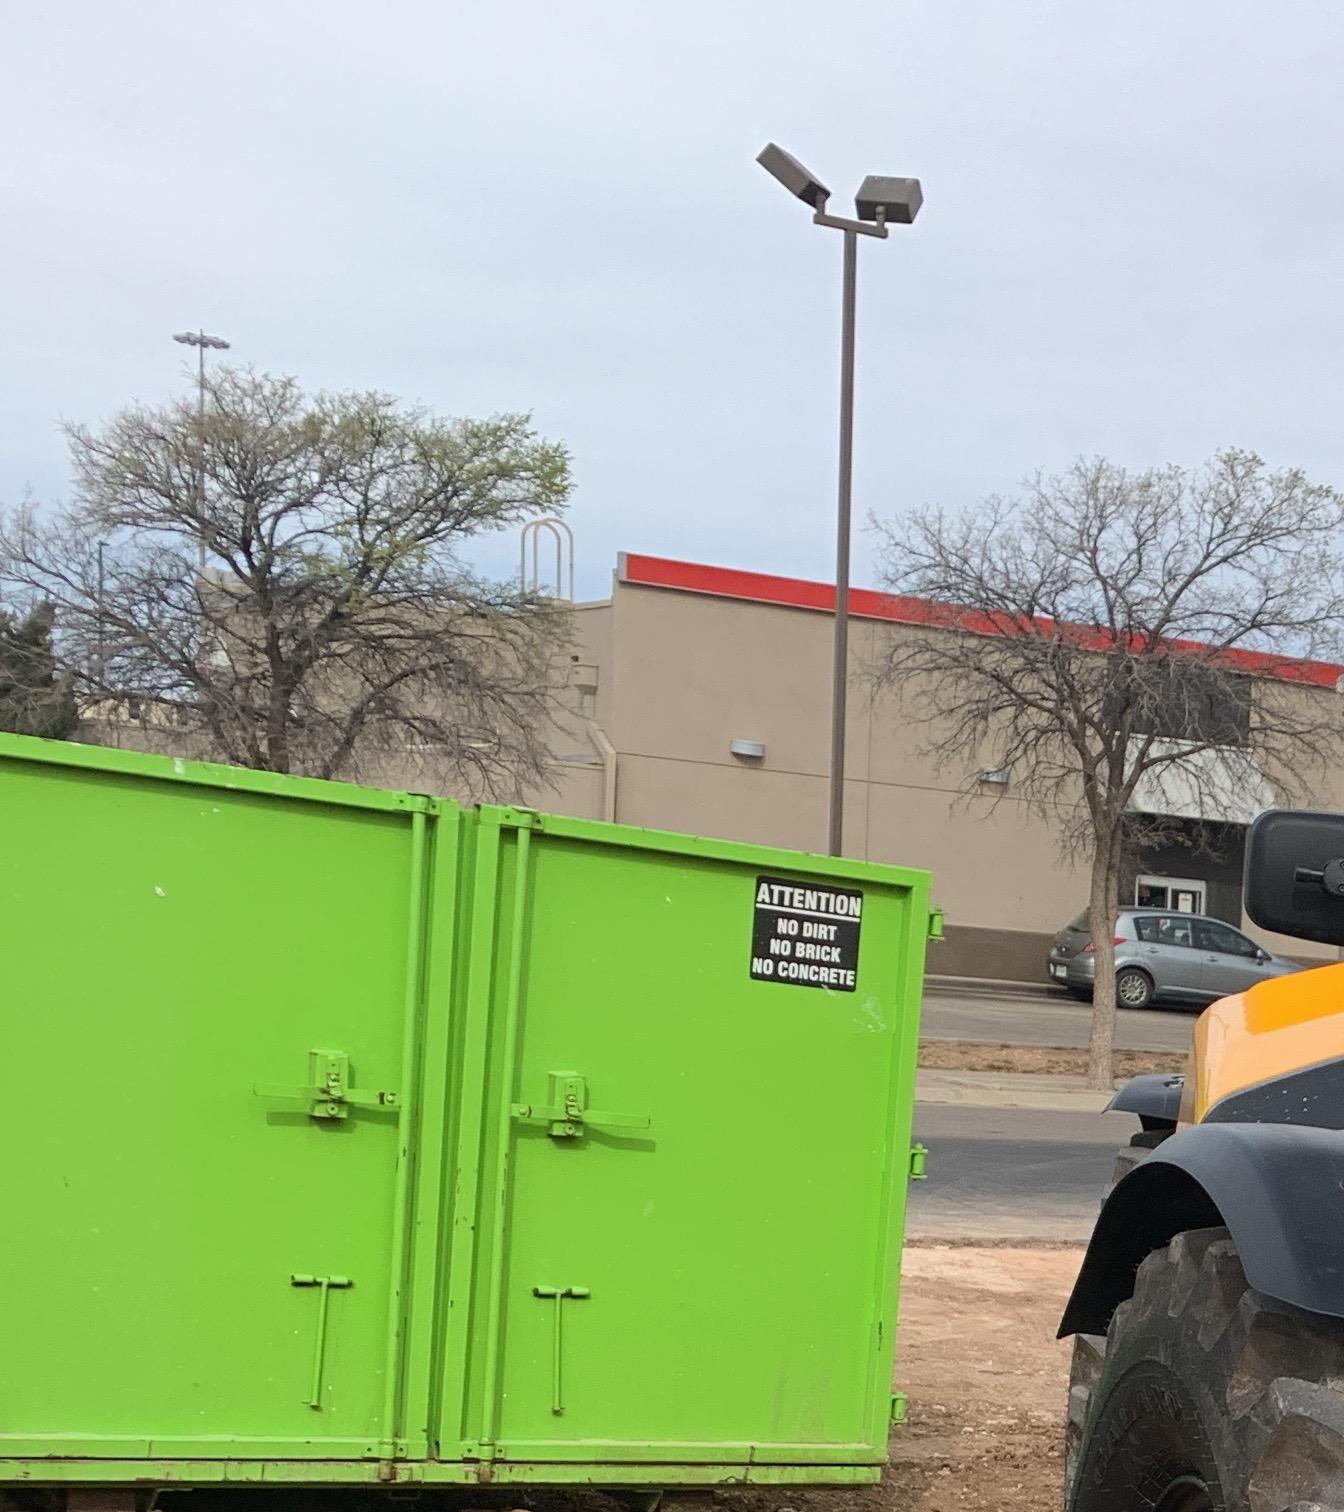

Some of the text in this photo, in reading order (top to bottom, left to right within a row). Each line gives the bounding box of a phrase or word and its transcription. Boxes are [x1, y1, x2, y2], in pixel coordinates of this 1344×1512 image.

[757, 883, 861, 916] ATTENTION
[777, 918, 838, 941] NO DIRT
[769, 938, 841, 963] NO BRICK
[752, 957, 856, 986] NO CONCRETE
